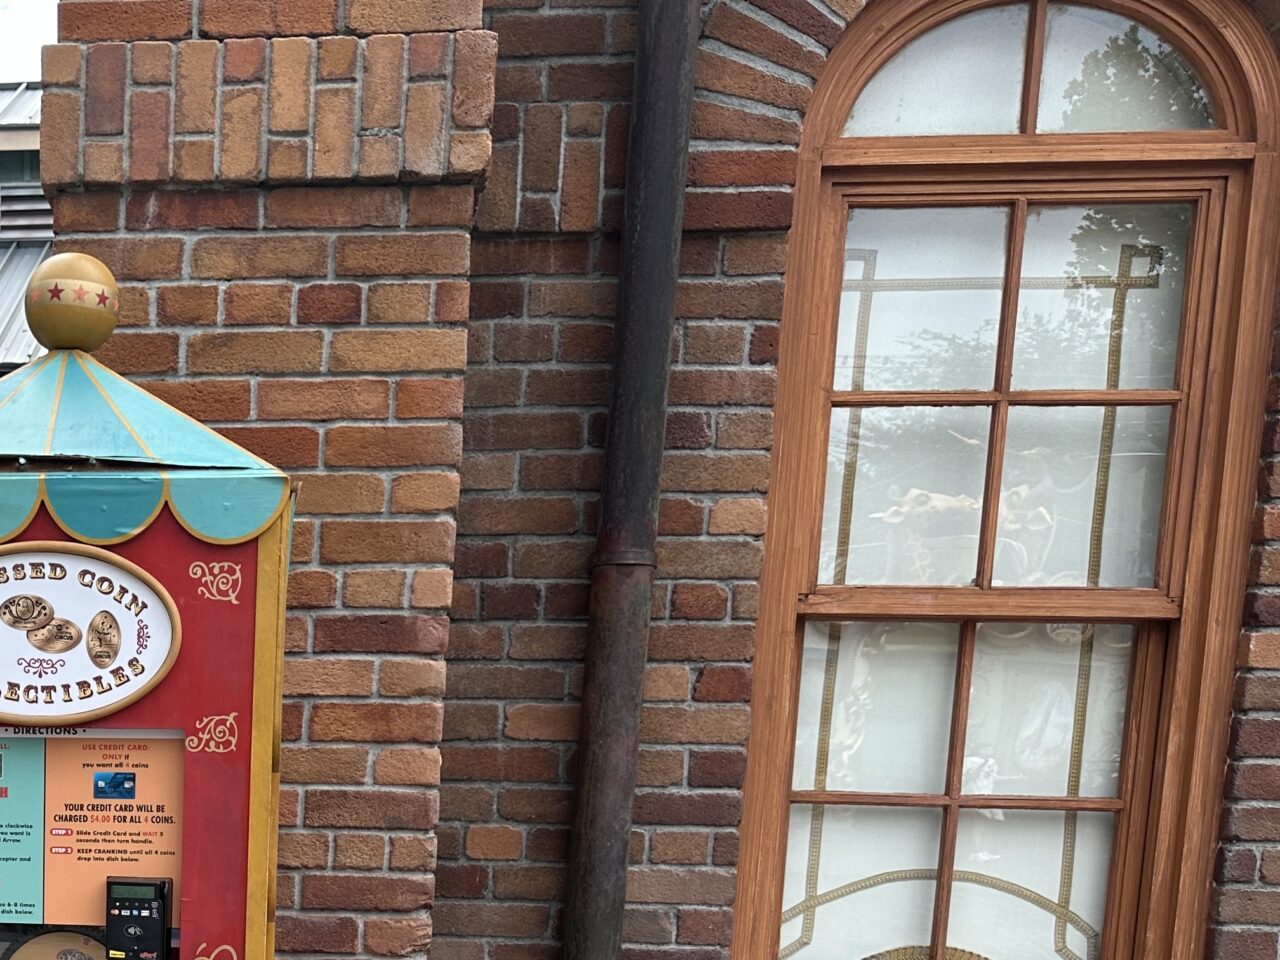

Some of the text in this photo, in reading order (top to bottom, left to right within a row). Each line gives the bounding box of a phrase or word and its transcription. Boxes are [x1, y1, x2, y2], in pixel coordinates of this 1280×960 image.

[78, 569, 149, 617] COIN
[13, 727, 78, 735] DIRECTIONS
[86, 804, 112, 812] CREDIT
[114, 804, 134, 812] CARD
[136, 804, 154, 812] WILL
[53, 814, 88, 823] CHARGED
[90, 815, 111, 823] $4.00
[150, 816, 177, 824] COINS.
